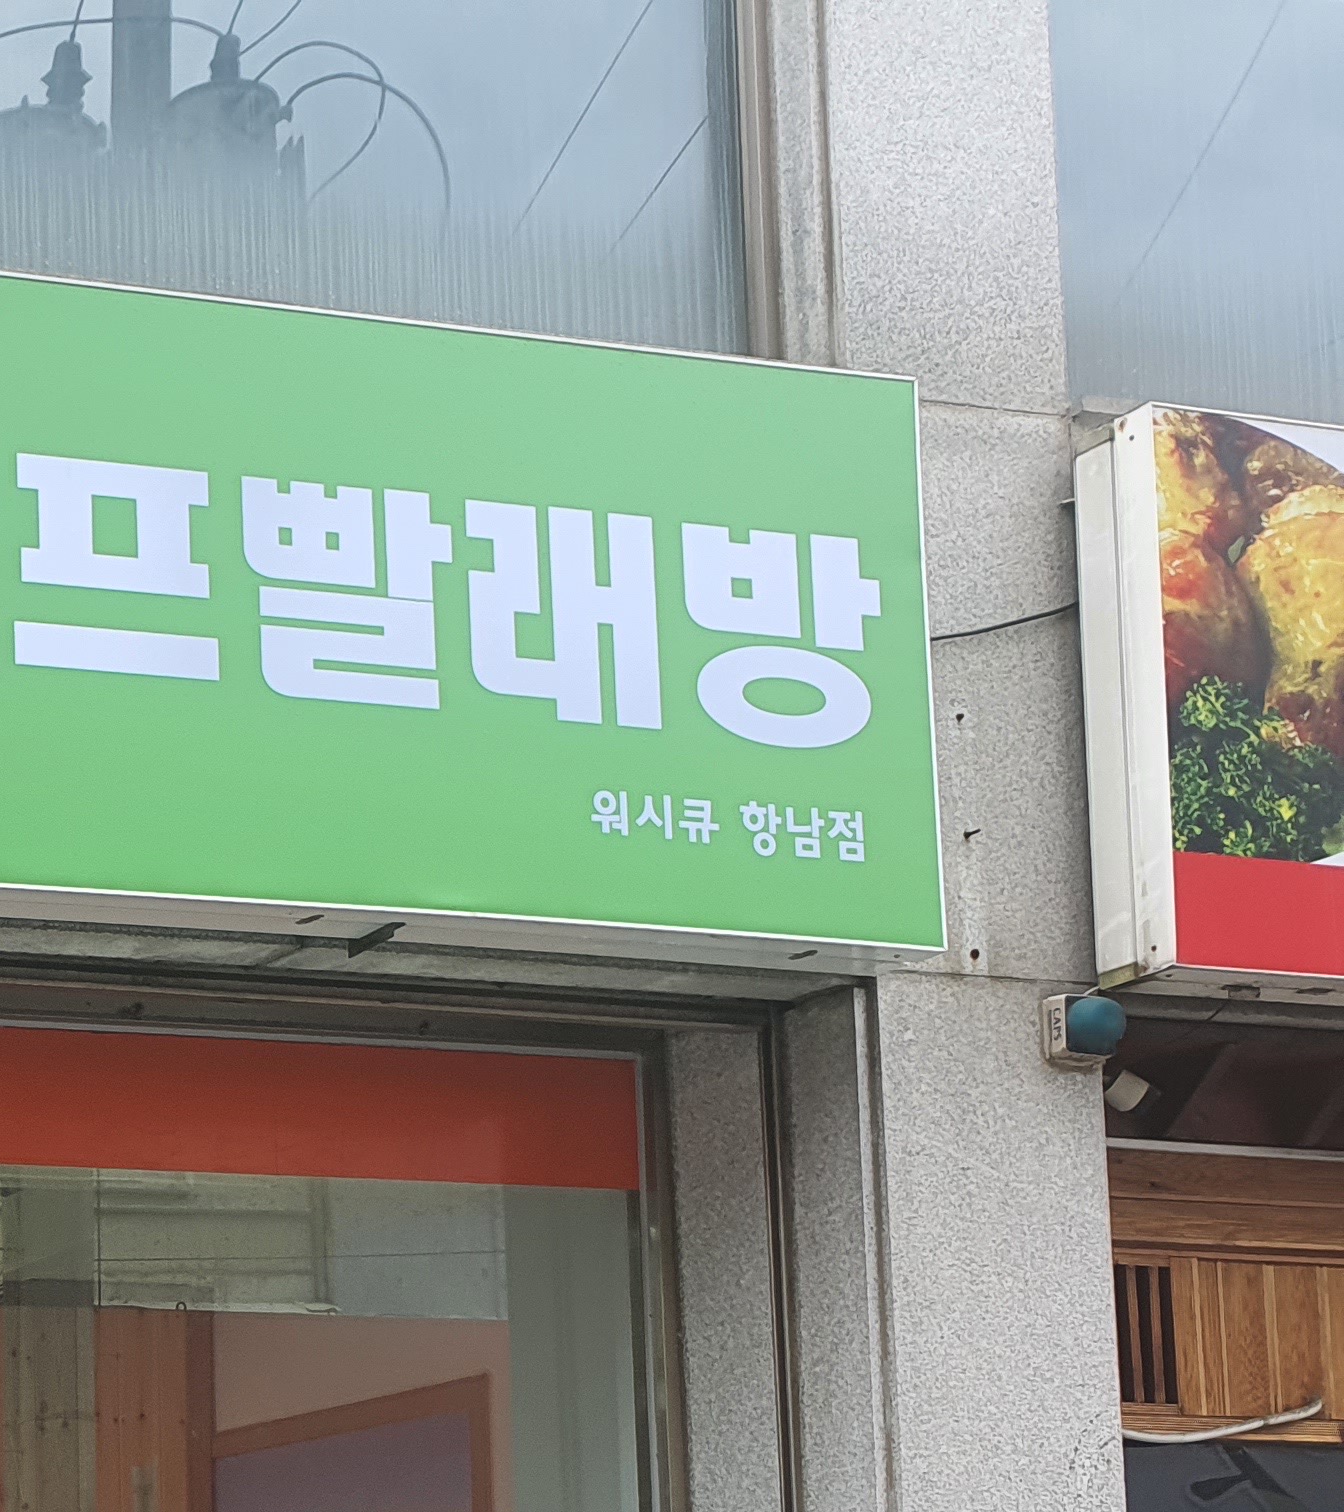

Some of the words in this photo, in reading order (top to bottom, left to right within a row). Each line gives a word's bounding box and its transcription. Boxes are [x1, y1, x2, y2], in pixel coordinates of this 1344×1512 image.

[591, 790, 720, 844] 워시큐
[739, 801, 865, 862] 항남점
[1052, 1007, 1062, 1041] CAPS
